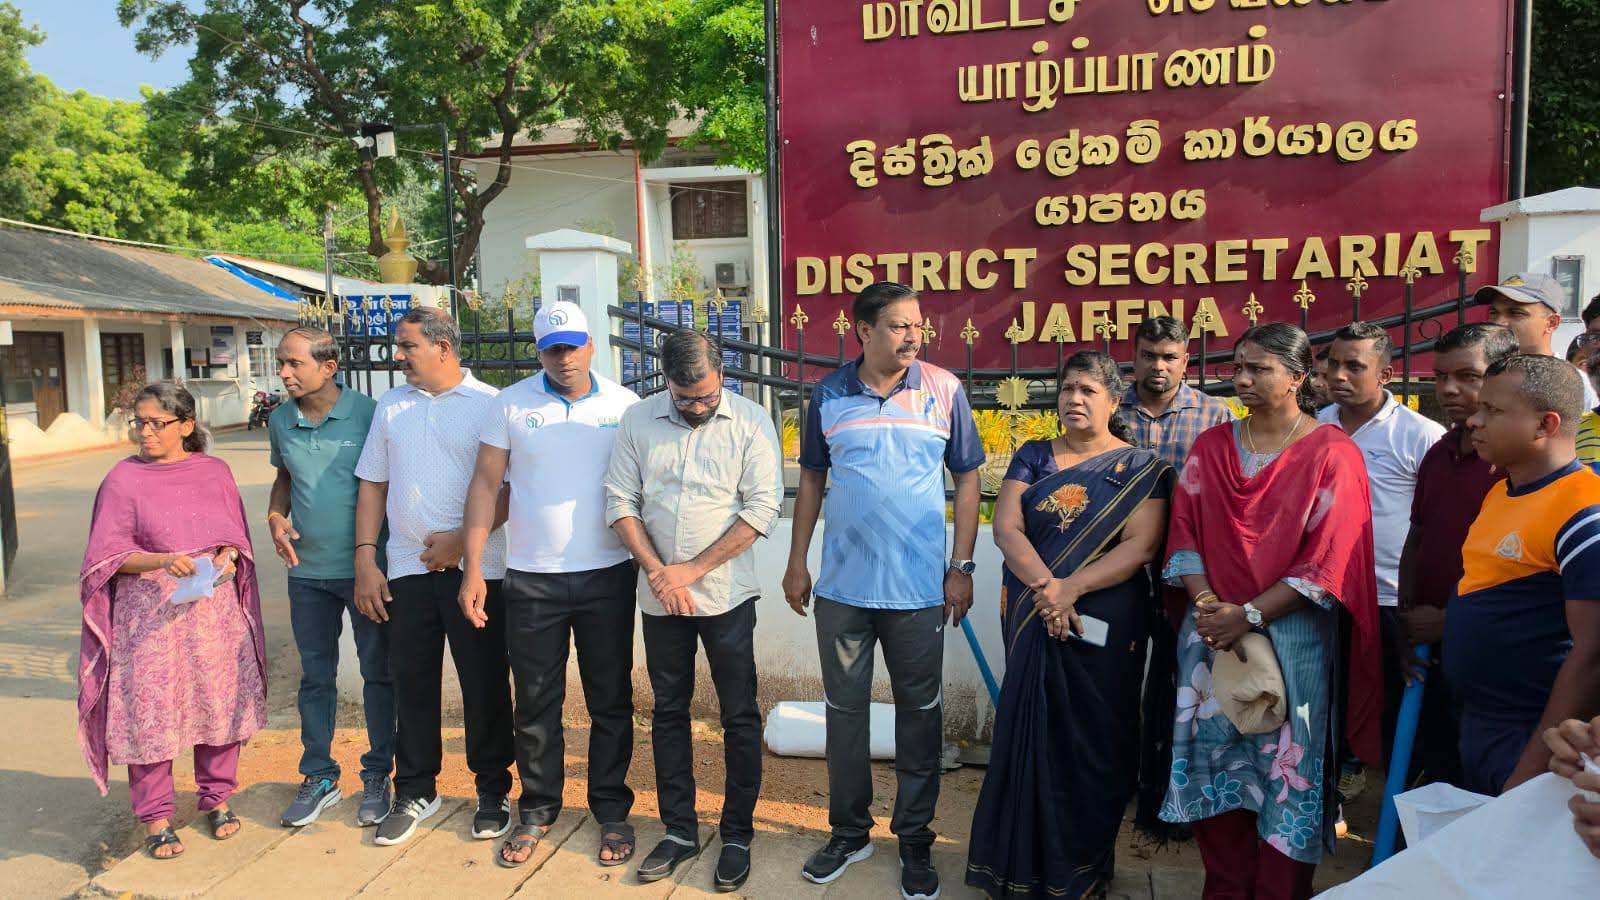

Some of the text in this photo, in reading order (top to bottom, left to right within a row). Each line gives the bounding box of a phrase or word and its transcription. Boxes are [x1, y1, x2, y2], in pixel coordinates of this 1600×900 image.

[959, 44, 1276, 111] யாழ்ப்பாணம்
[1016, 120, 1162, 177] ලේකම්
[1184, 116, 1419, 164] කාර්යාලය
[1036, 189, 1207, 226] යාපනය
[796, 229, 1491, 295] DISTRICT SECRETARIAT
[1017, 297, 1229, 344] JAFFNA
